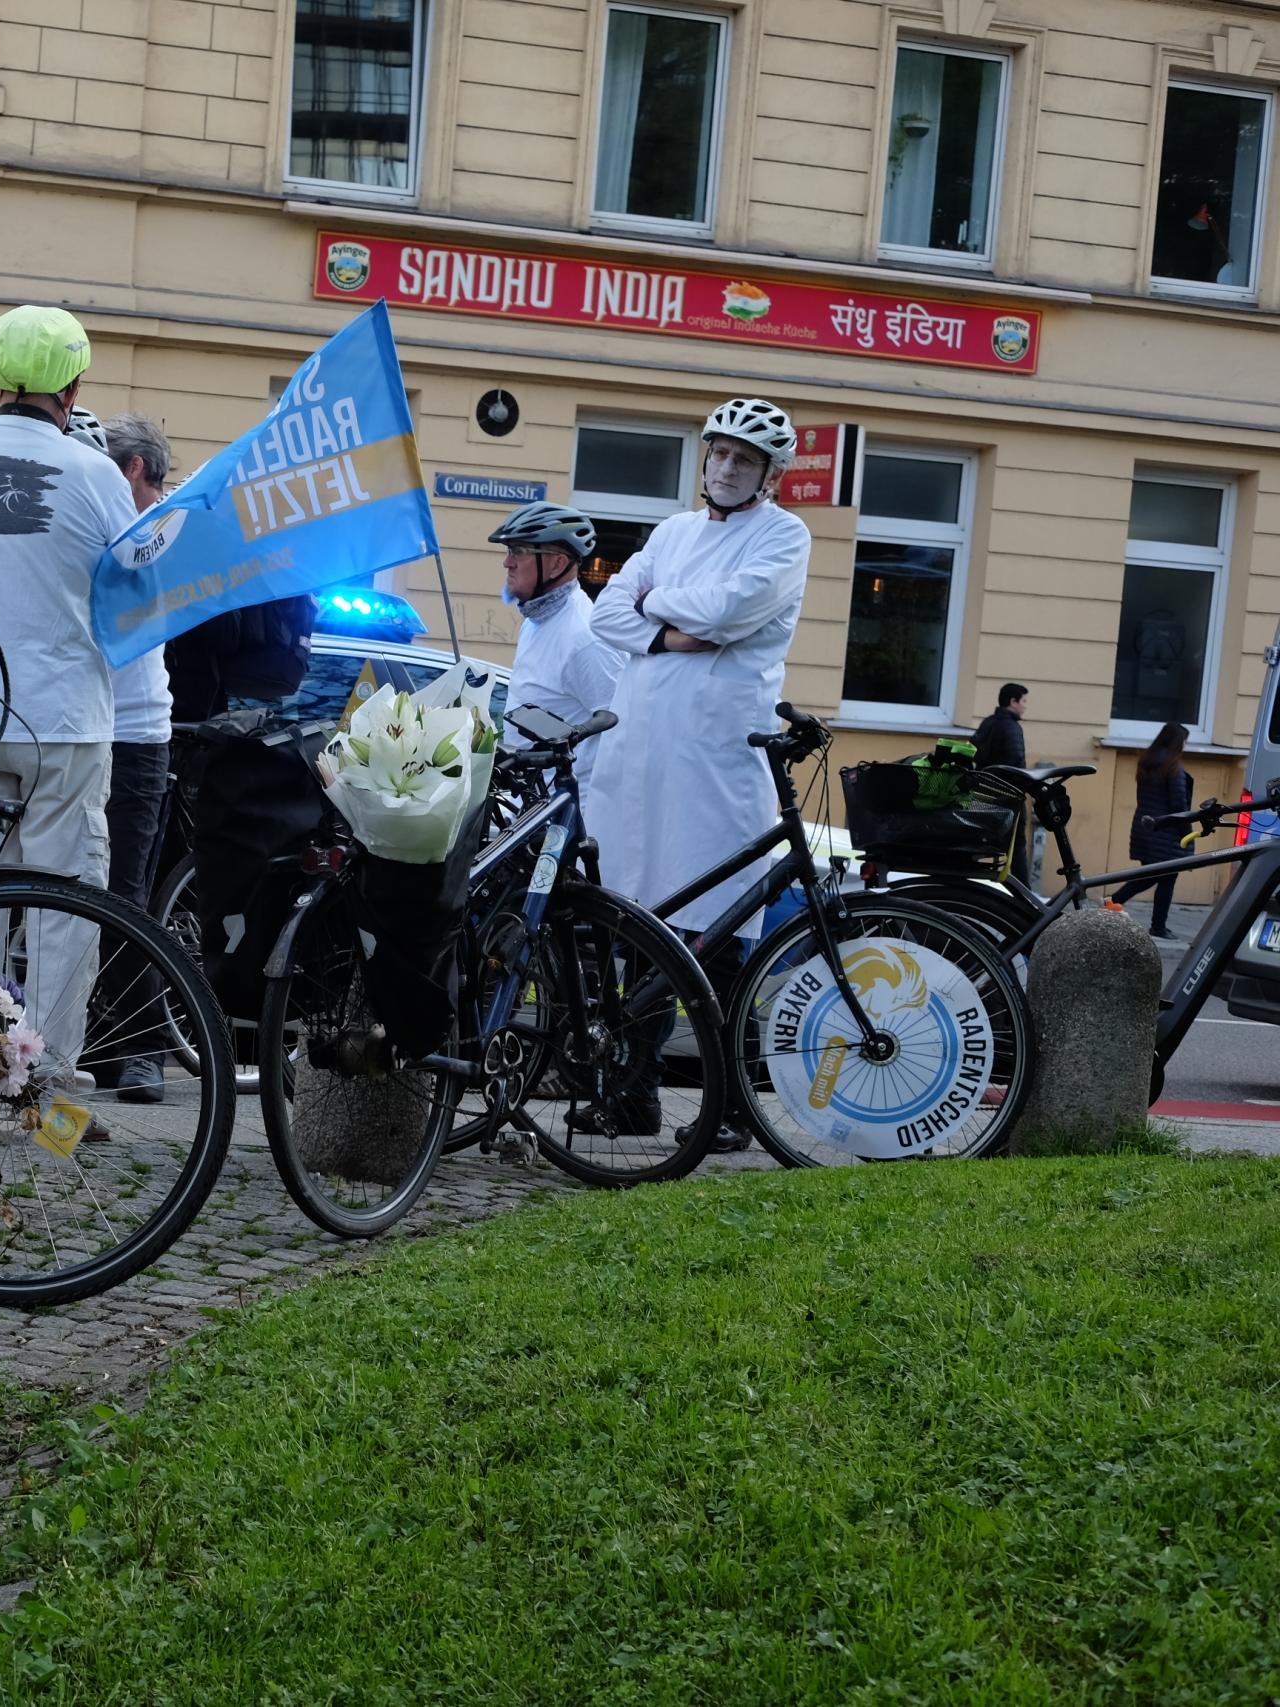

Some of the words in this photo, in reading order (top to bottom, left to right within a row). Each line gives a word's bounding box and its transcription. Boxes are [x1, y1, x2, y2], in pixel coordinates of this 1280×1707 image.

[331, 243, 368, 258] Ayinger
[398, 247, 557, 312] SANDHU
[580, 265, 687, 329] INDIA
[687, 315, 731, 330] original
[734, 320, 781, 336] indische
[829, 299, 877, 348] संधु
[884, 303, 966, 349] इंडिया
[996, 318, 1028, 332] Ayinger
[444, 476, 538, 501] Corneliusstr.
[1182, 946, 1215, 995] CUBE
[774, 971, 823, 1052] BAYERN
[896, 1007, 987, 1148] RADENTSCHEID
